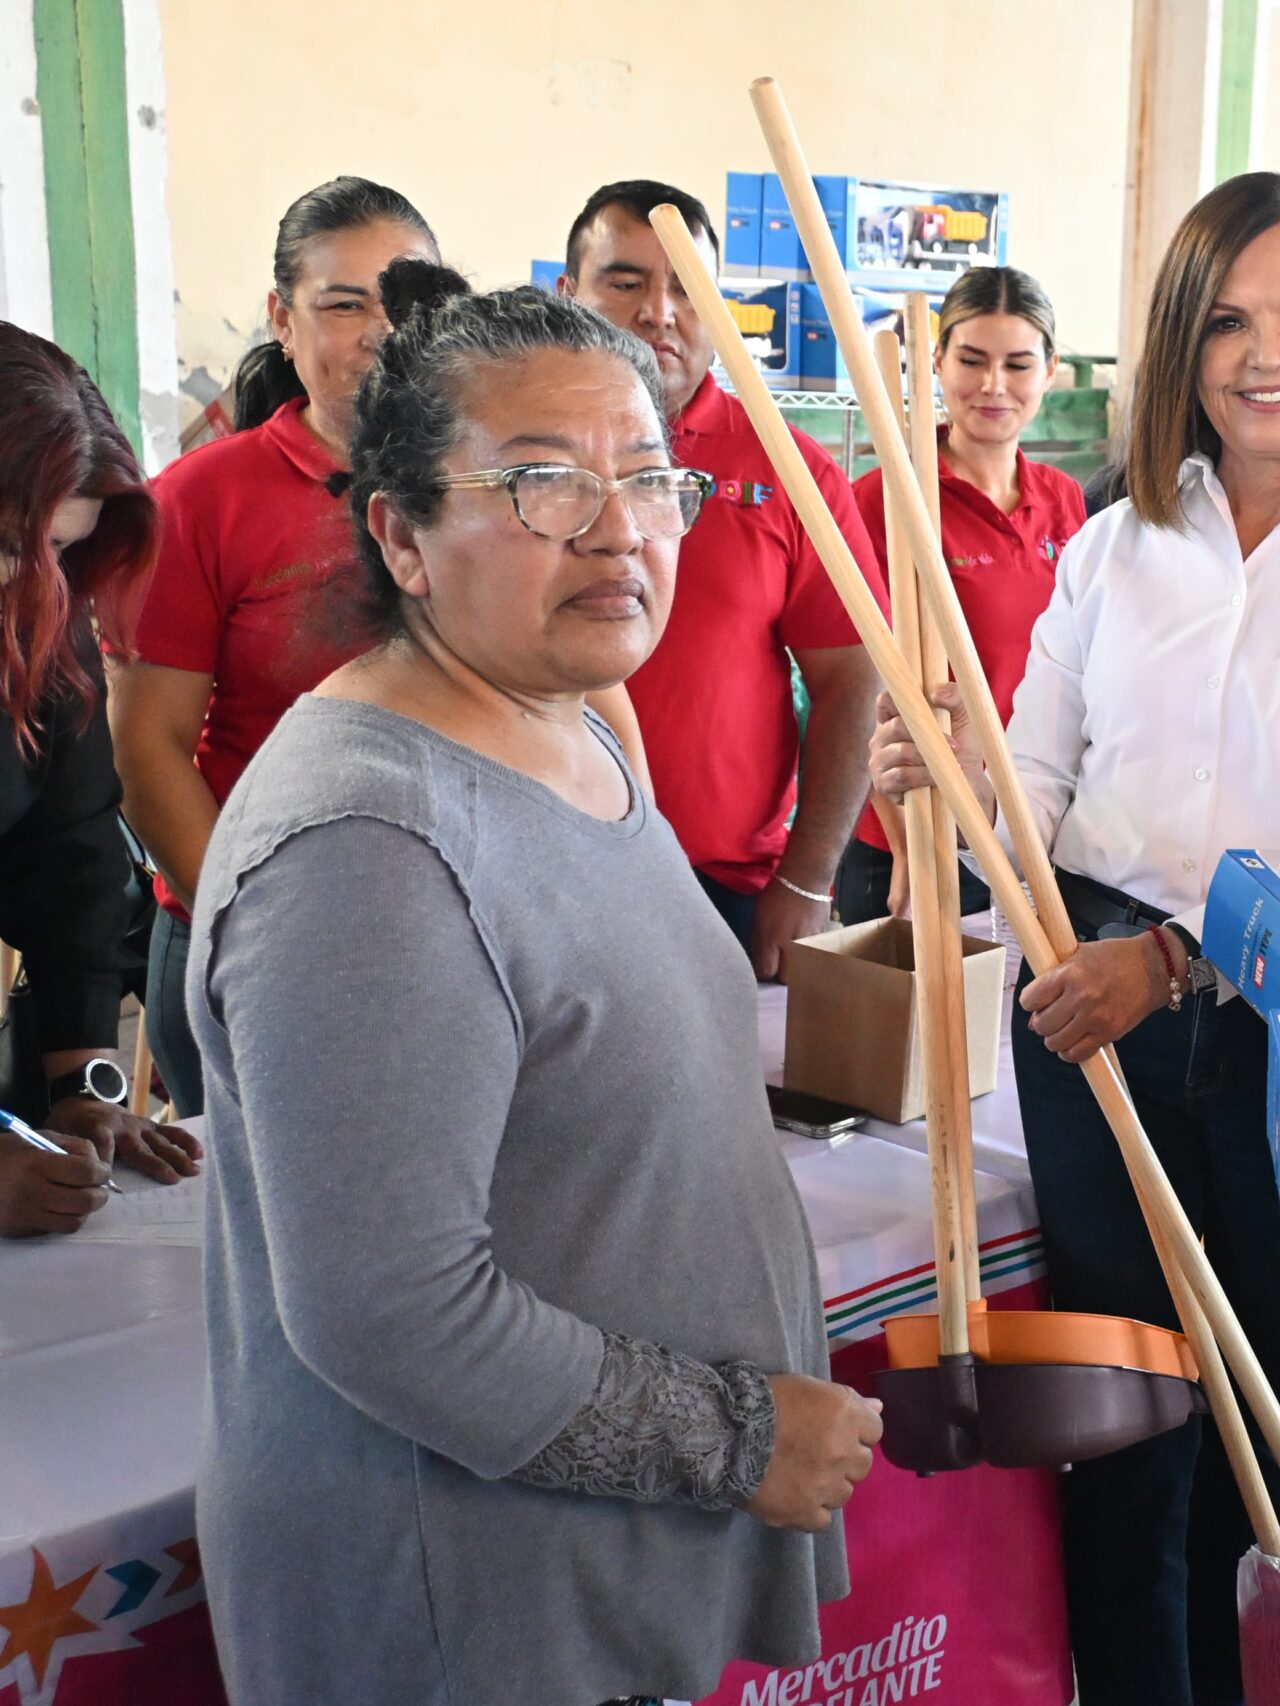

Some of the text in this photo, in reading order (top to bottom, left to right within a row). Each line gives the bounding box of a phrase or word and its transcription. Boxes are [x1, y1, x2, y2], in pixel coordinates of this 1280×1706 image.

[719, 480, 774, 505] DIF
[1243, 898, 1265, 940] Truck
[1259, 928, 1273, 956] TYPE
[1237, 943, 1251, 990] Heavy
[1254, 957, 1265, 988] NEW
[740, 1613, 949, 1706] Mercadito
